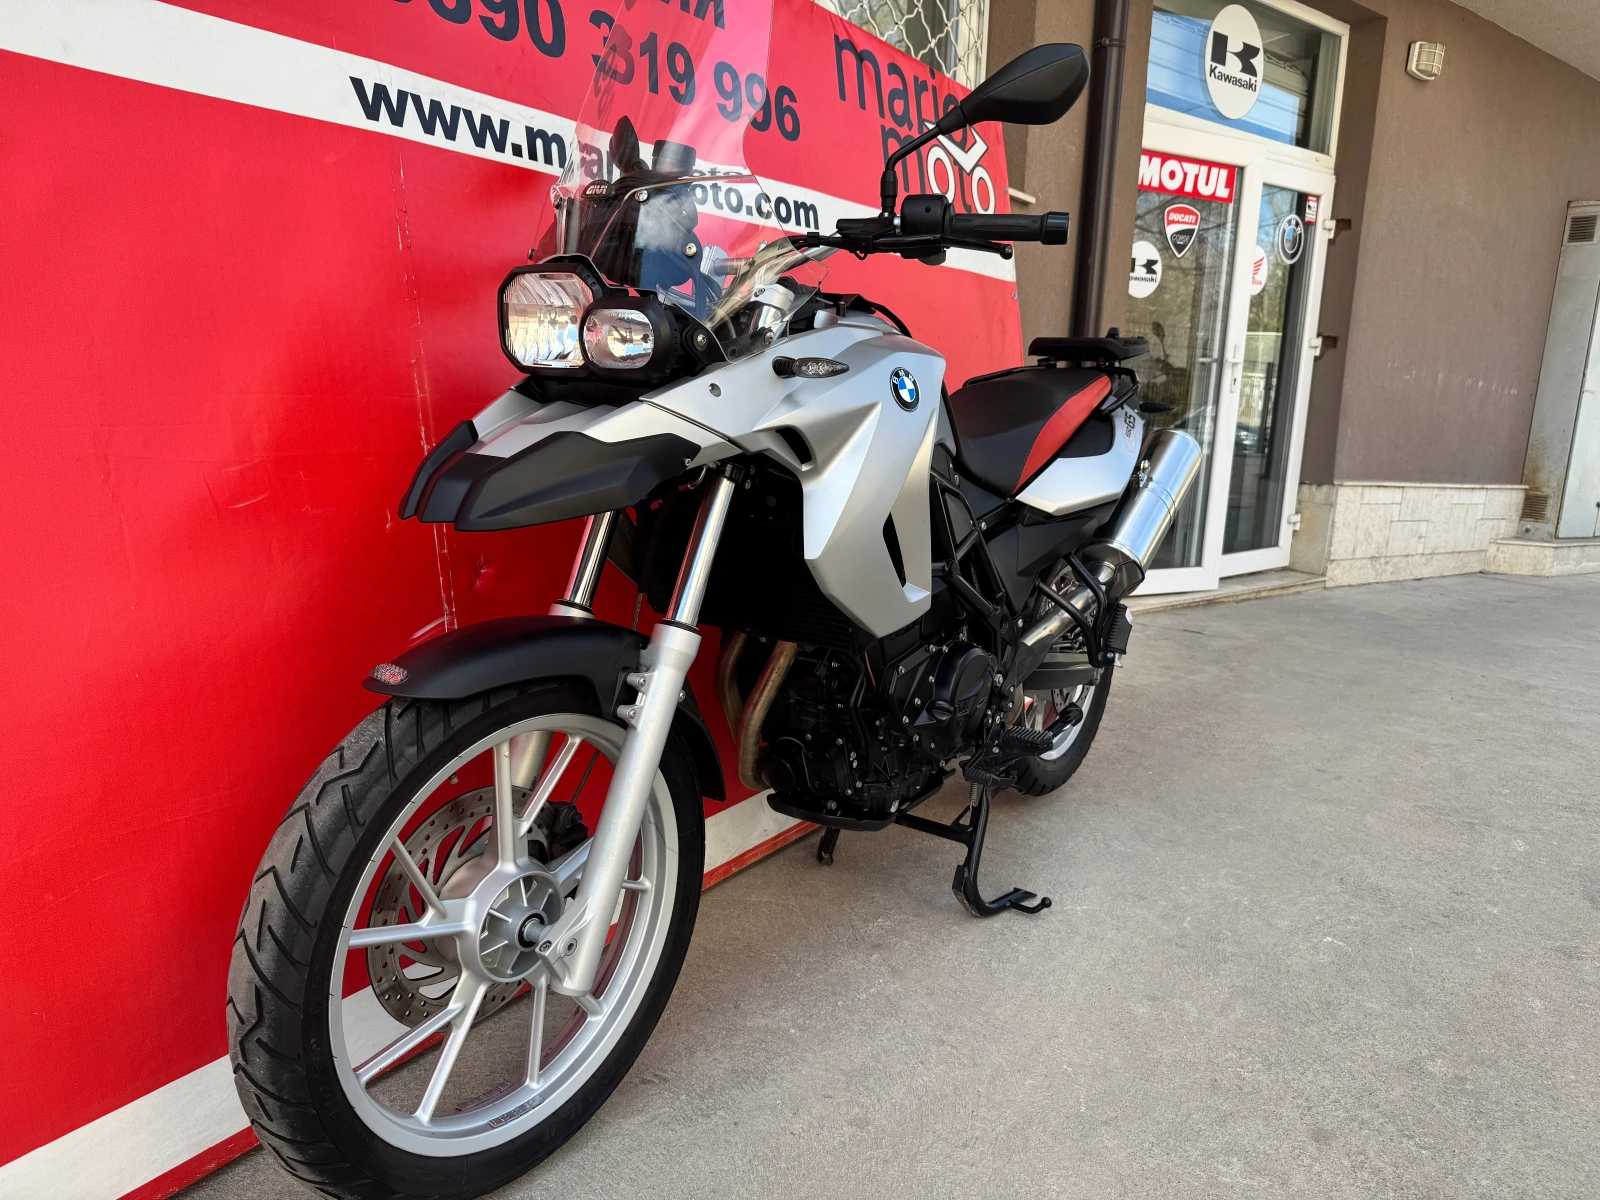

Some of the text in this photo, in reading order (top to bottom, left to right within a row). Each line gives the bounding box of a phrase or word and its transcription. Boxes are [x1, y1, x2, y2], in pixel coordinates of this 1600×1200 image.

[589, 9, 696, 106] 319
[713, 60, 801, 142] 996
[1209, 64, 1257, 92] Kawasaki
[1138, 154, 1230, 199] MOTUL
[1168, 212, 1196, 223] DUCATI
